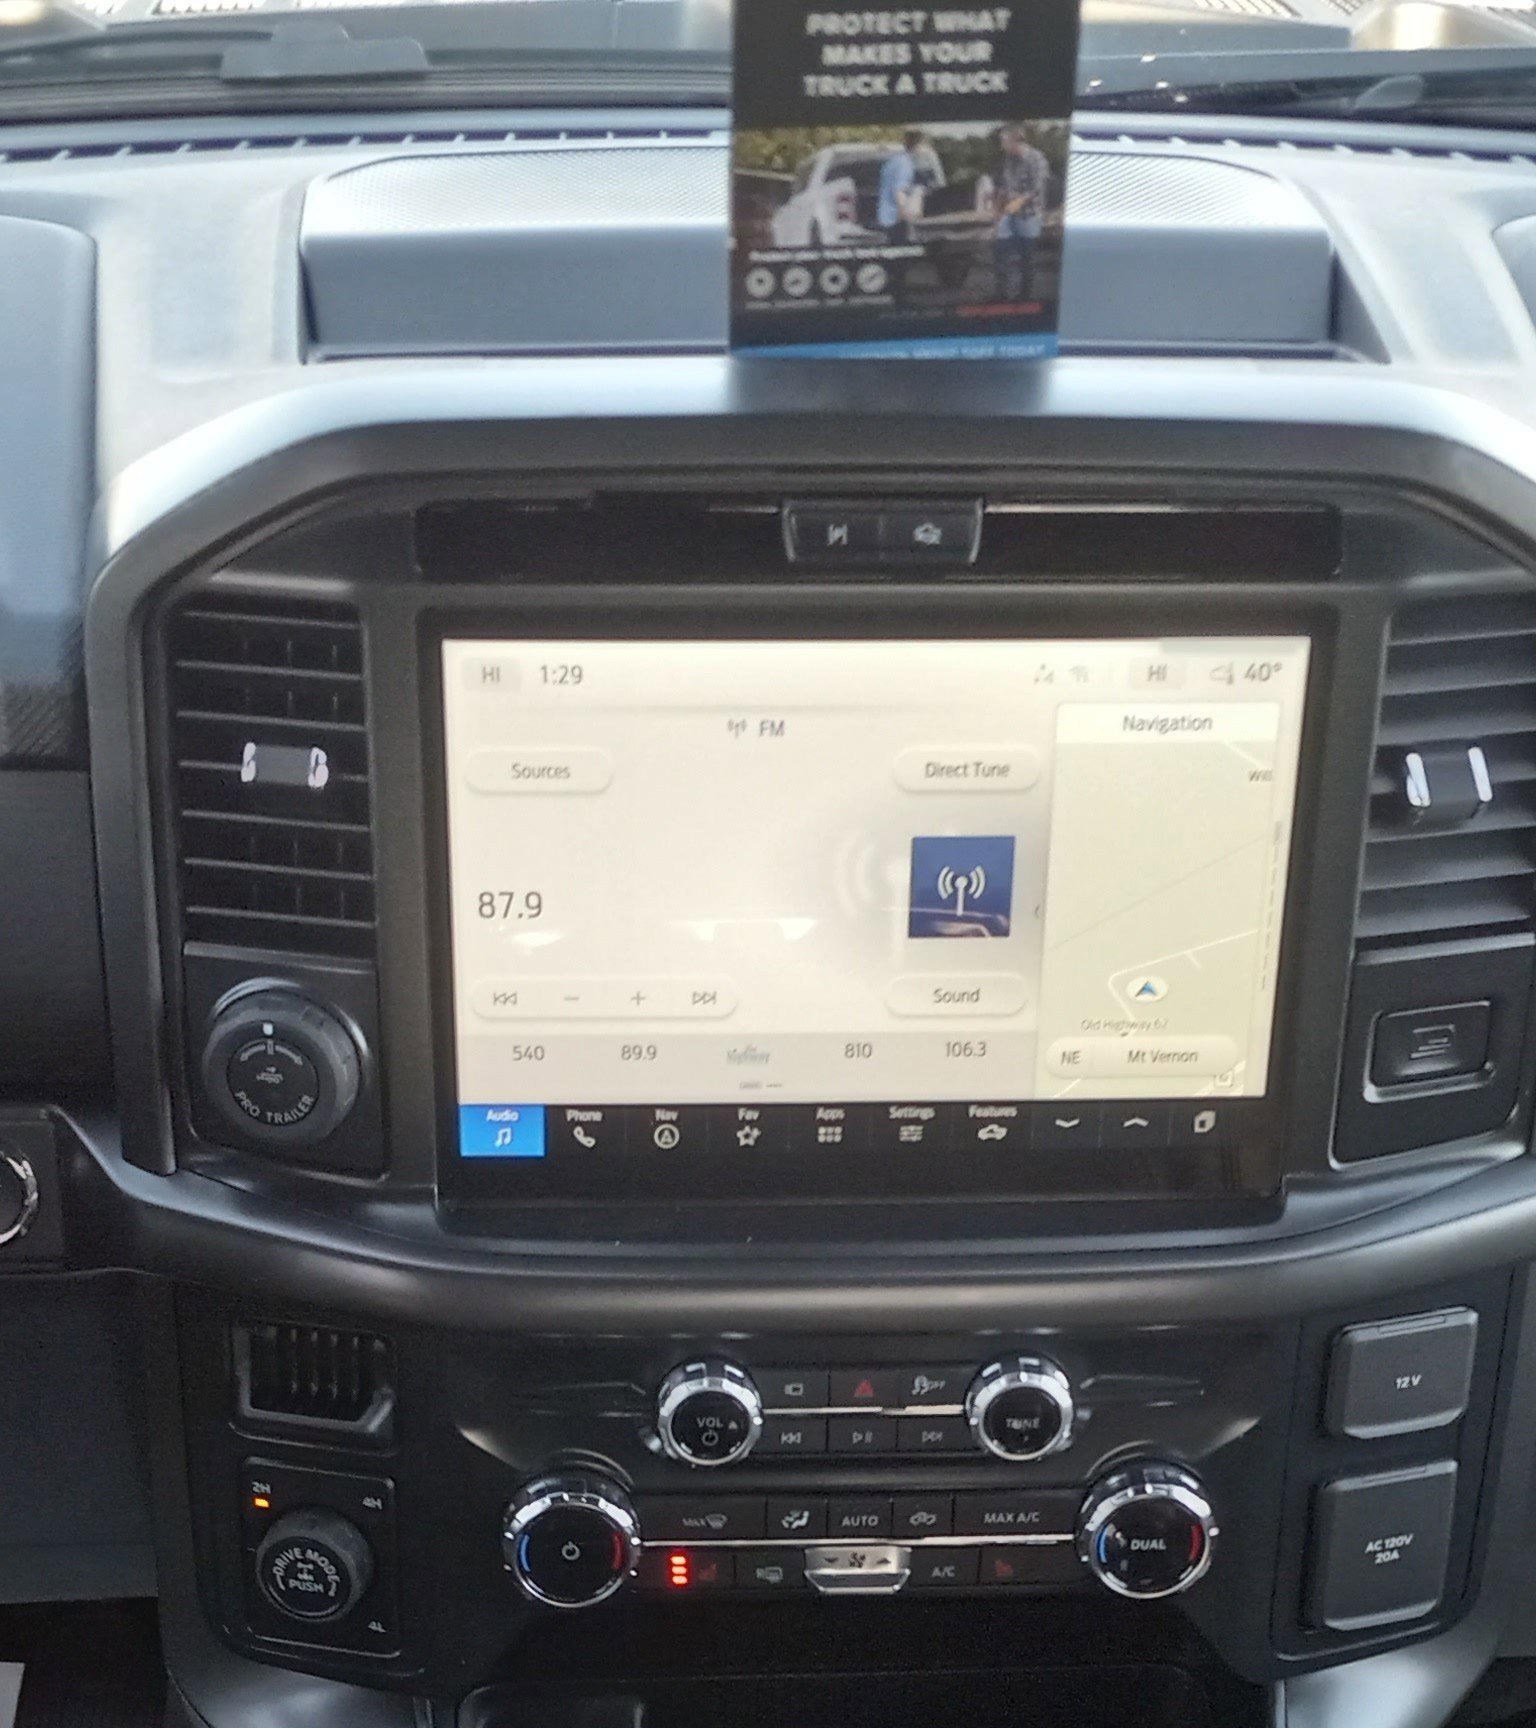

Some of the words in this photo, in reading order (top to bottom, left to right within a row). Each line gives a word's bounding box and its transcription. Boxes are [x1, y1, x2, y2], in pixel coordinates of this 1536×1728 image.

[806, 11, 927, 35] PROTECT
[933, 8, 1012, 33] WHAT
[821, 43, 912, 66] MAKES
[918, 40, 993, 63] YOUR
[803, 74, 890, 98] TRUCK
[894, 74, 916, 96] A
[922, 71, 1009, 95] TRUCK
[480, 666, 501, 684] HI
[539, 665, 584, 686] 1:29
[1147, 664, 1168, 683] HI
[758, 720, 786, 738] FM
[1122, 714, 1213, 735] Navigation
[511, 762, 572, 781] Sources
[924, 760, 968, 779] Direct
[972, 760, 1011, 779] Tune
[477, 889, 544, 921] 87.9
[933, 987, 981, 1004] Sound
[511, 1044, 546, 1062] 540
[620, 1043, 658, 1062] 89.9
[844, 1042, 873, 1059] 810
[944, 1040, 988, 1059] 106.3
[1060, 1050, 1081, 1066] NE
[1127, 1050, 1147, 1064] Mt
[1150, 1050, 1199, 1064] Vernon
[235, 1090, 262, 1118] PRO
[265, 1094, 314, 1125] TRAILER
[485, 1107, 520, 1122] Audio
[566, 1107, 603, 1122] Phone
[654, 1107, 678, 1122] Nav
[737, 1107, 760, 1121] Fav
[816, 1106, 846, 1121] Apps
[889, 1105, 936, 1121] Settings
[968, 1104, 1019, 1119] Features
[696, 1416, 724, 1429] VOL
[1005, 1418, 1041, 1430] TUNE
[841, 1514, 880, 1528] AUTO
[983, 1511, 1013, 1525] MAX
[1016, 1510, 1041, 1524] A/C
[1130, 1538, 1167, 1551] DUAL
[1365, 1539, 1383, 1554] AC
[1383, 1533, 1413, 1550] 120V
[272, 1547, 304, 1577] DRIVE
[305, 1548, 341, 1584] MODE
[1374, 1550, 1401, 1565] 20A
[931, 1565, 956, 1579] A/C
[288, 1579, 325, 1594] PUSH
